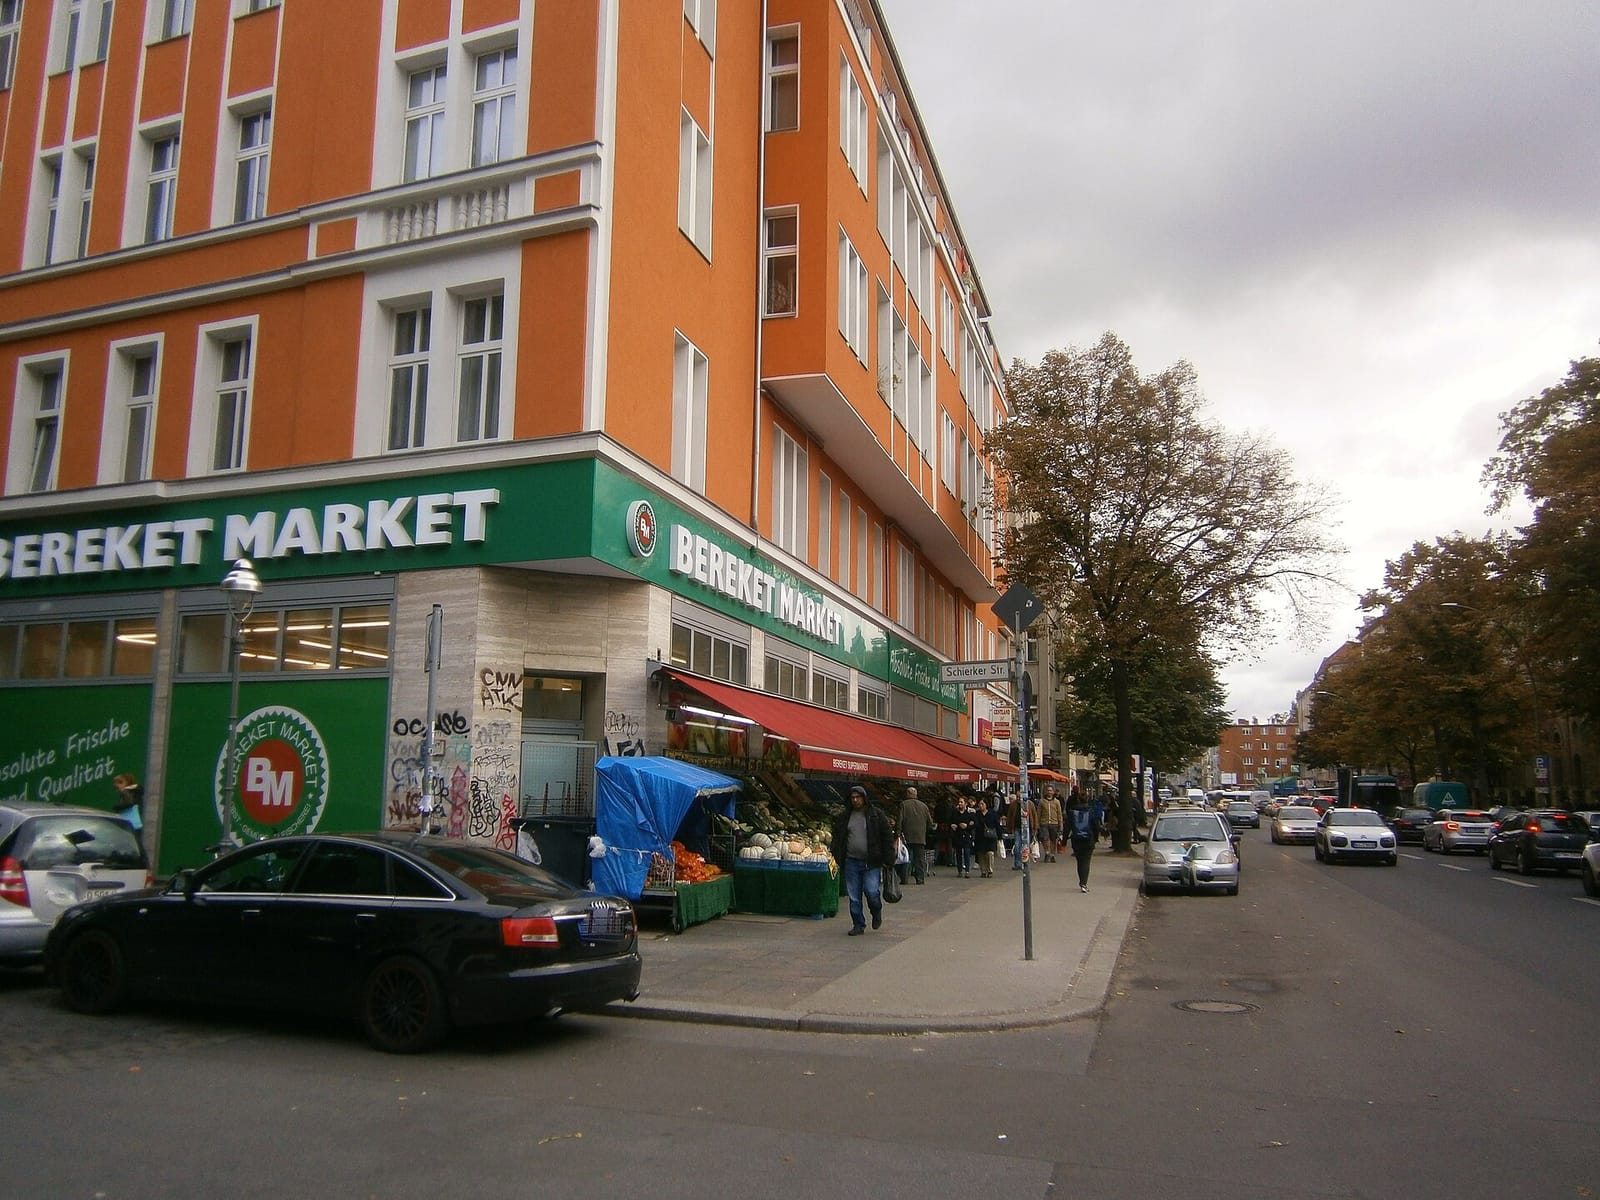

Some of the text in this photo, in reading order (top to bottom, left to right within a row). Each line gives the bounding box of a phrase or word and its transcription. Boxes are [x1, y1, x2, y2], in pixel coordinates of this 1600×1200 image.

[223, 488, 500, 561] MARKET
[669, 525, 842, 646] BEREKET MARKET
[946, 665, 1006, 677] Schierker Str.
[0, 718, 130, 781] solute Frische
[39, 756, 115, 801] Qualität
[280, 722, 318, 788] MARKET
[247, 757, 295, 806] BM
